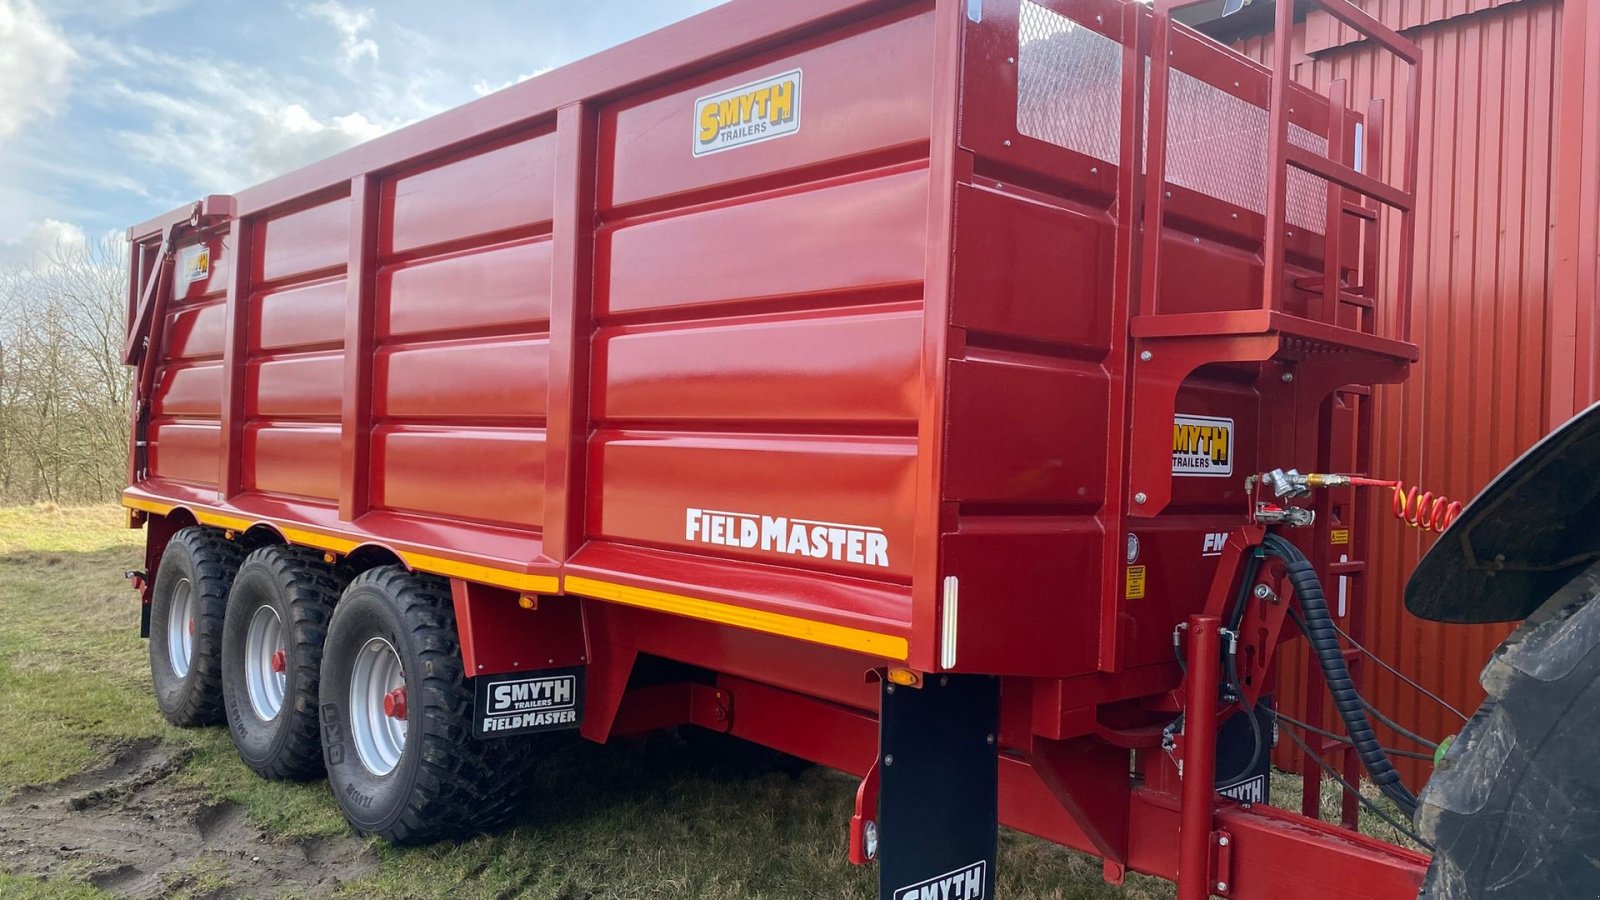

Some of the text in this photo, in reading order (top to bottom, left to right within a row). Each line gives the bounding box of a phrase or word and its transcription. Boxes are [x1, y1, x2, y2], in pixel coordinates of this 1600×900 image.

[700, 80, 796, 145] SMYTH
[721, 122, 767, 143] TRAILERS
[1173, 424, 1230, 466] MYTH
[1173, 456, 1210, 468] TRAILERS
[685, 507, 890, 568] FIELDMASTER
[494, 679, 571, 710] SMYTH
[514, 699, 552, 710] TRAILERS
